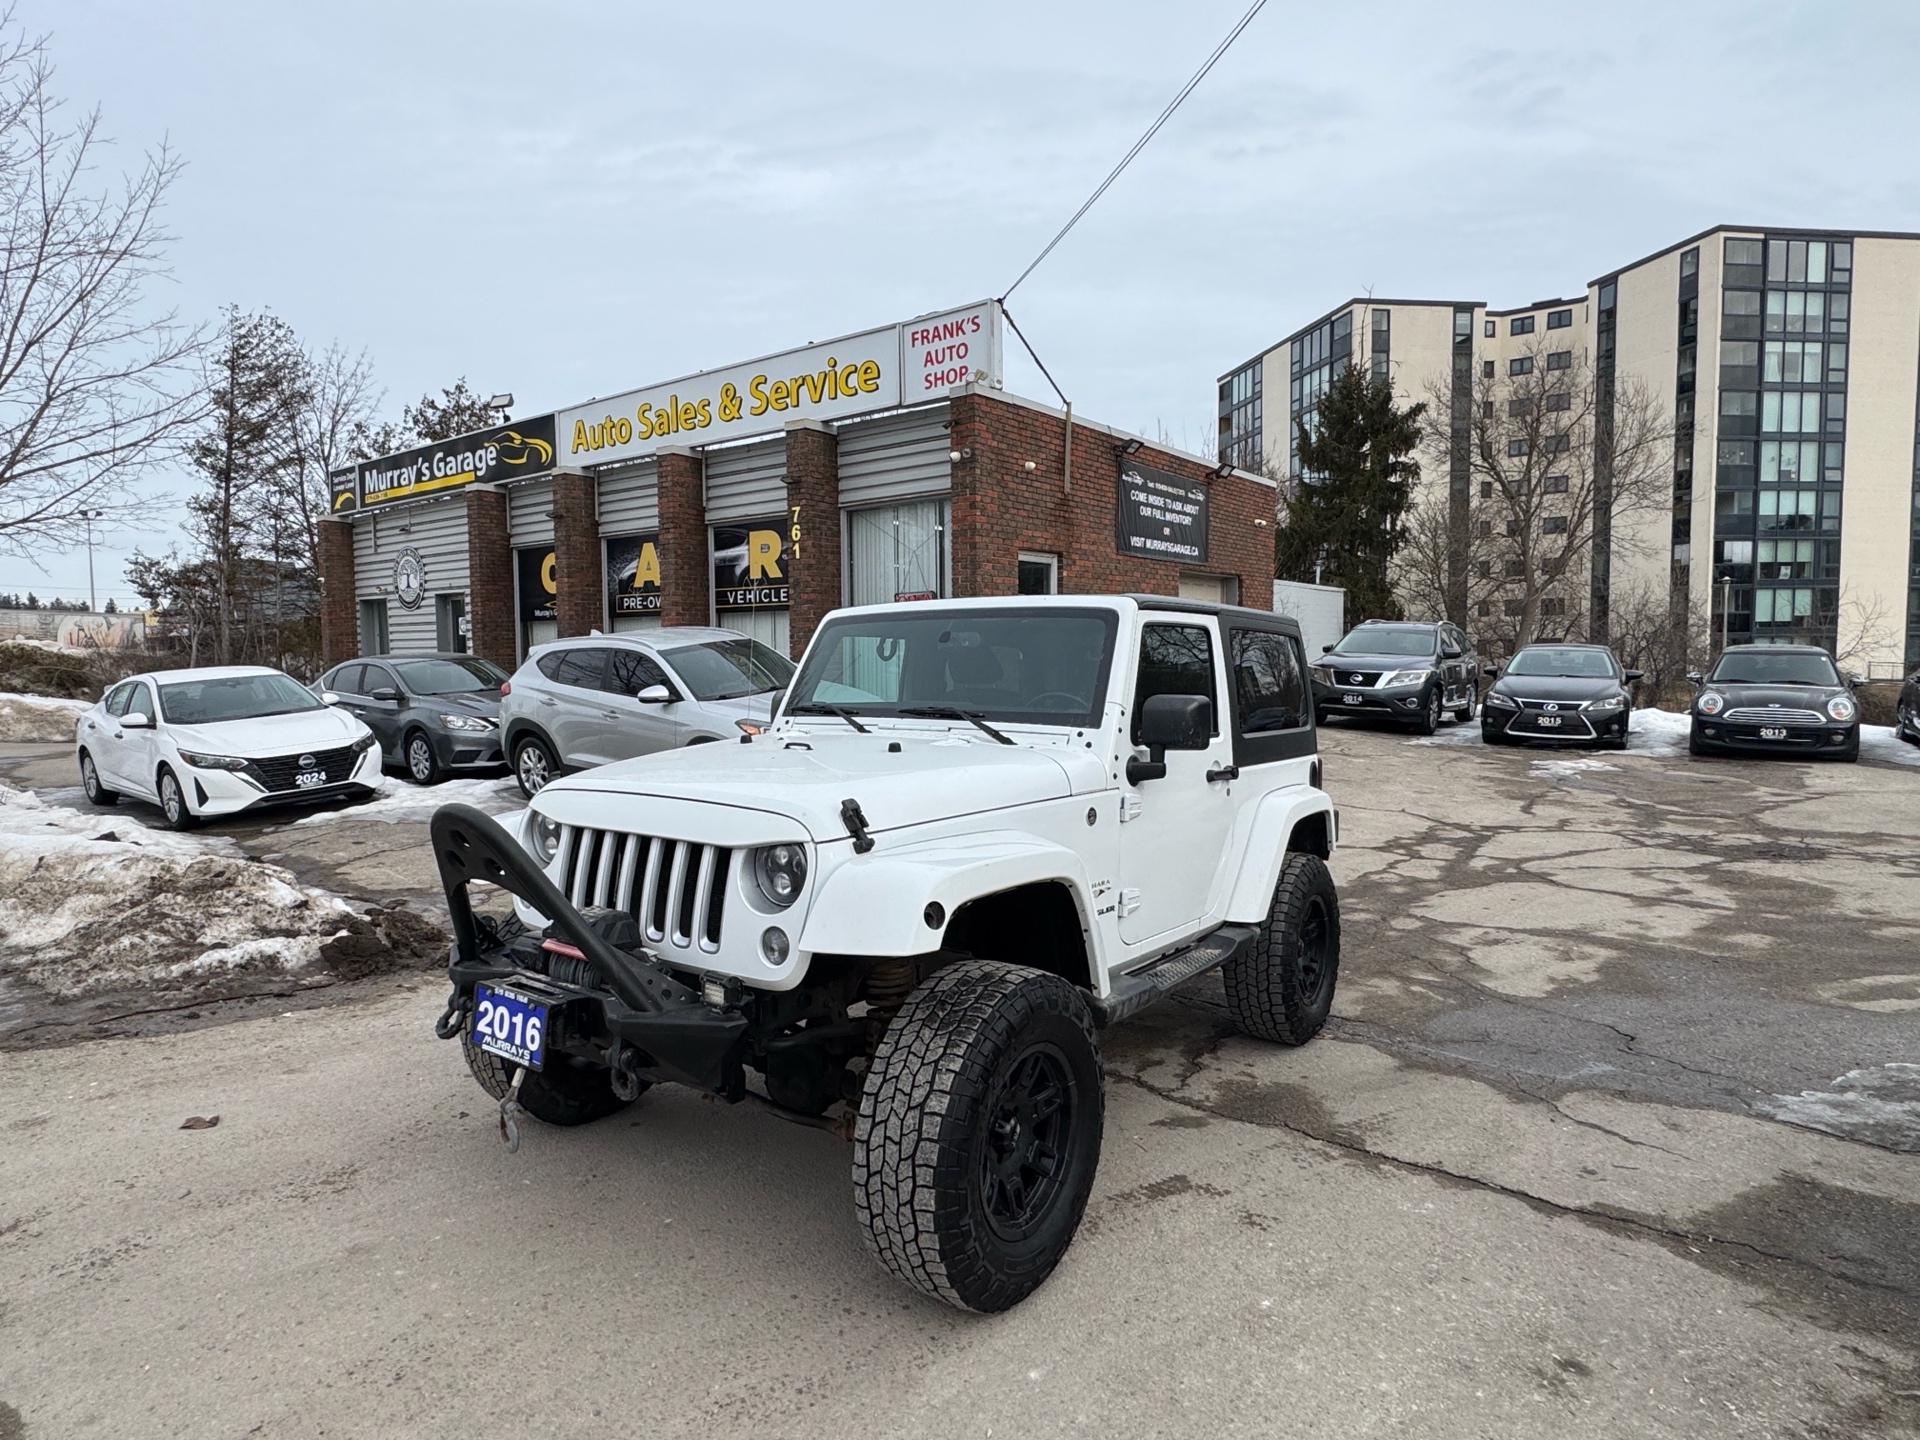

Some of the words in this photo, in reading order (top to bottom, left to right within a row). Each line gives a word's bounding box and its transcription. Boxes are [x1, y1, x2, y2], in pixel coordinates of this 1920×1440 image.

[911, 315, 981, 348] FRANK'S
[924, 342, 968, 368] AUTO
[924, 365, 968, 390] SHOP
[571, 414, 632, 453] Auto
[637, 394, 711, 440] Sales
[717, 383, 743, 422] &
[749, 357, 881, 417] Service
[364, 457, 430, 494] Murray's
[432, 445, 498, 478] Garage
[1130, 490, 1148, 503] COME
[1148, 494, 1165, 508] INSIDE
[1172, 501, 1183, 511] ASK
[1183, 504, 1199, 515] ABOUT
[1140, 506, 1152, 517] OUR
[1152, 510, 1165, 520] FULL
[1165, 512, 1192, 526] INVENTORY
[749, 529, 783, 580] R
[1130, 536, 1145, 548] VISIT
[1342, 694, 1362, 702] 2014
[1537, 716, 1562, 724] 2015
[1760, 728, 1787, 736] 2013
[295, 771, 327, 785] 2024
[476, 1000, 541, 1051] 2016
[482, 1035, 530, 1060] MURRAYS
